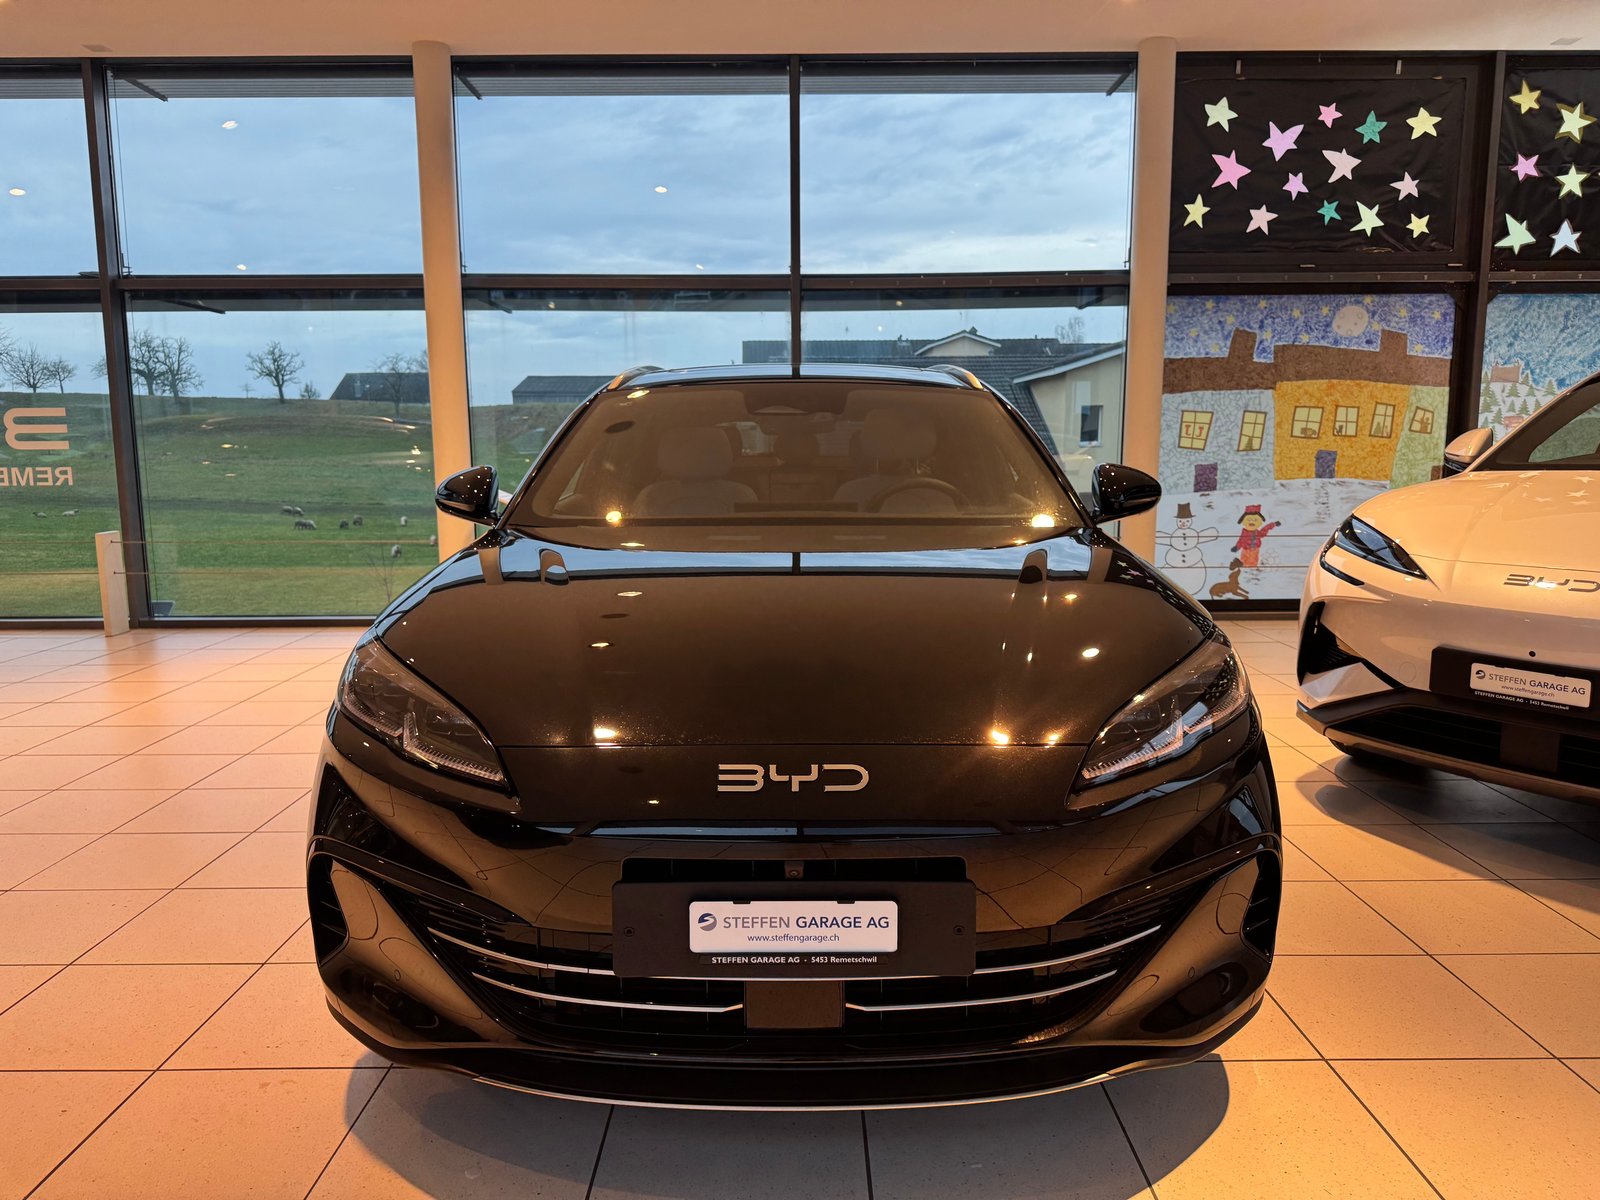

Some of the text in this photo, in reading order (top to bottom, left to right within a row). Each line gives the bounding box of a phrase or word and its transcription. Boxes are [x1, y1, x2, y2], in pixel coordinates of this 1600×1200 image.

[1488, 673, 1586, 695] STEFFEN GARAGE AG
[1495, 694, 1516, 702] GARAGE
[717, 763, 870, 793] BYD
[723, 916, 890, 929] STEFFEN GARAGE AG
[747, 933, 840, 943] www.steffengarage.ch
[711, 956, 749, 964] STEFFEN
[750, 956, 786, 964] GARAGE
[787, 956, 800, 964] AG
[811, 956, 828, 964] 5453
[830, 955, 877, 964] Remetschwil
